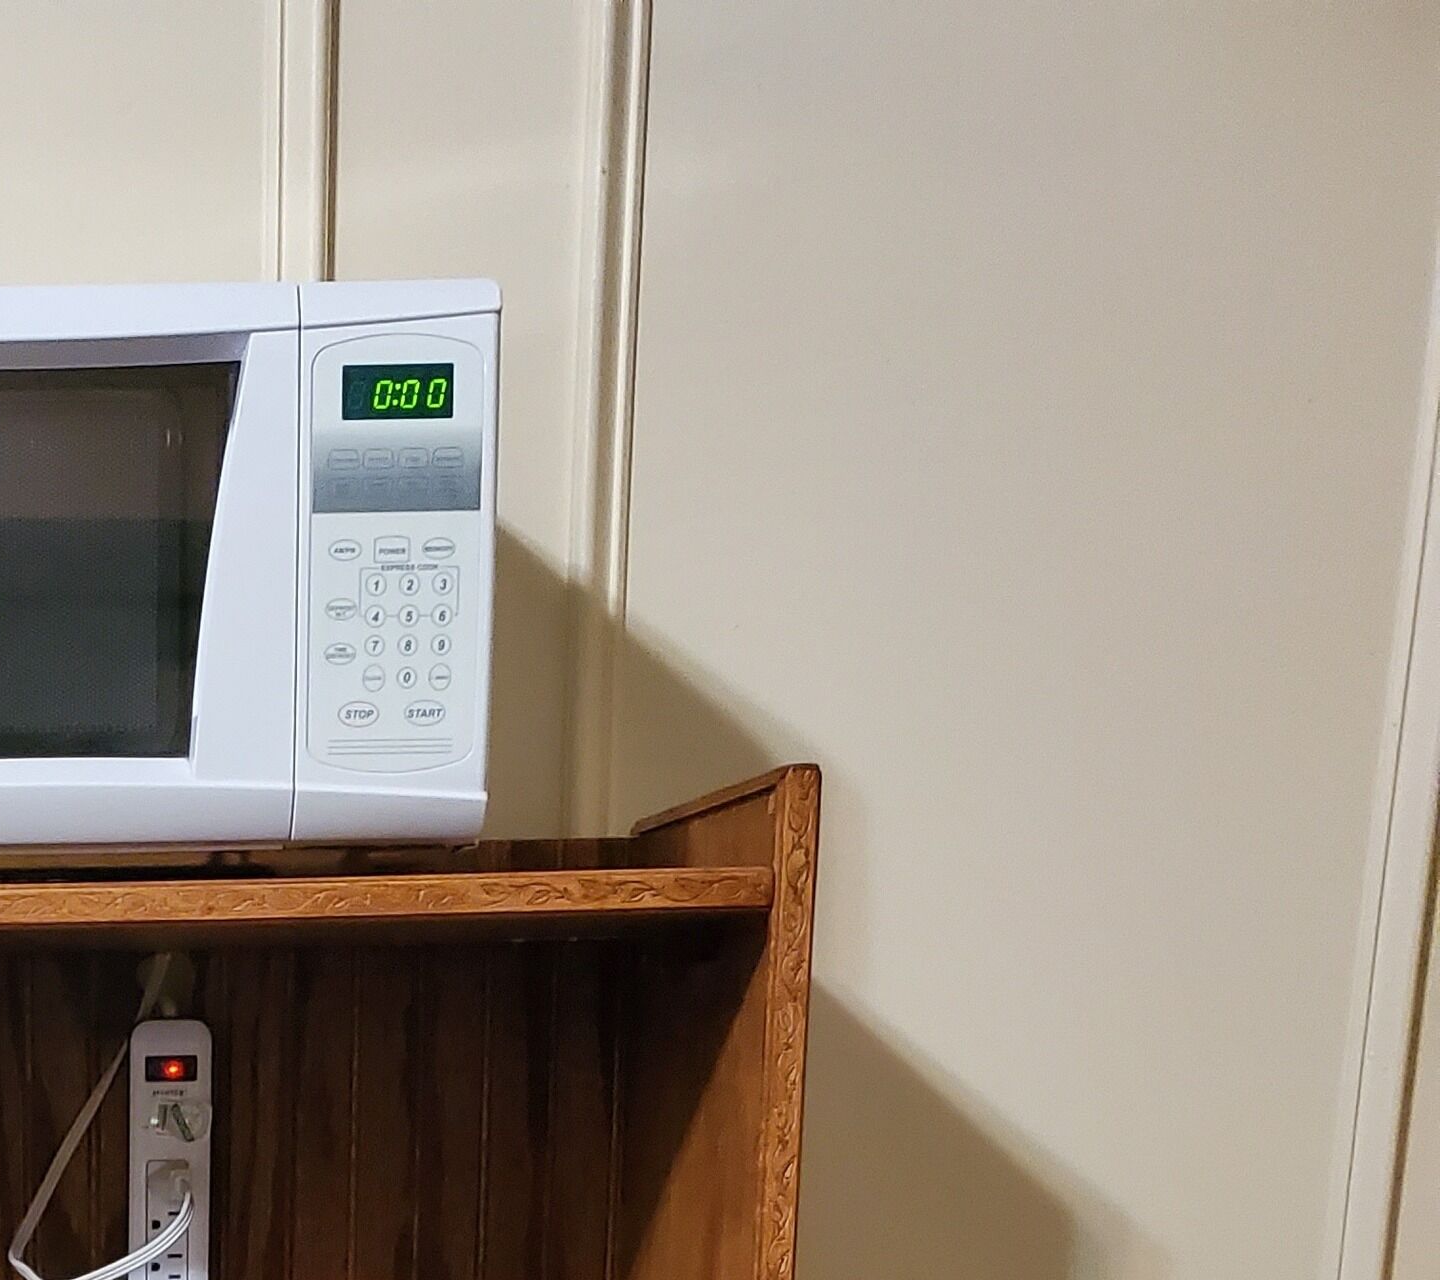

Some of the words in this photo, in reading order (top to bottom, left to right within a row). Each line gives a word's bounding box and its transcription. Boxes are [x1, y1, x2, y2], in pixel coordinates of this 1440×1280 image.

[373, 379, 447, 409] 0:00
[372, 579, 380, 591] 1
[406, 579, 414, 591] 2
[439, 578, 447, 590] 3
[371, 611, 380, 622] 4
[405, 611, 413, 622] 5
[438, 610, 446, 621] 6
[372, 640, 380, 651] 7
[404, 640, 412, 651] 8
[438, 639, 446, 650] 9
[403, 671, 411, 683] 0
[344, 709, 374, 720] STOP
[407, 708, 443, 719] START
